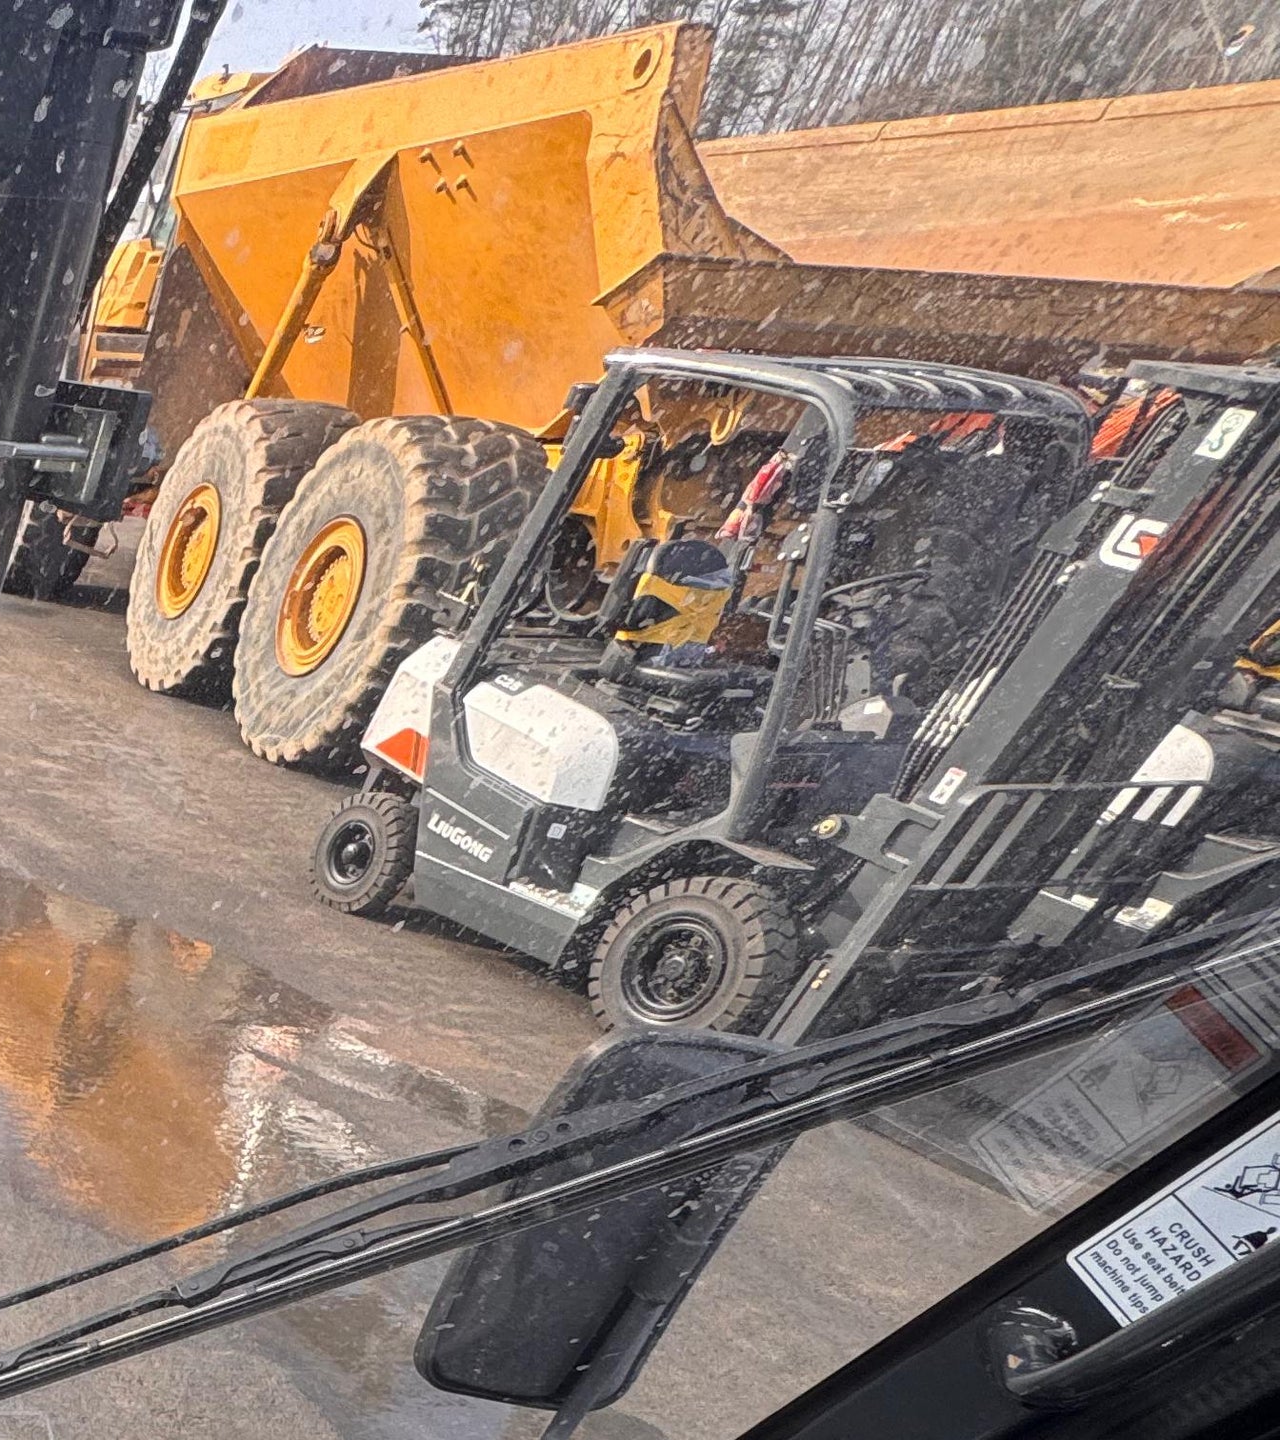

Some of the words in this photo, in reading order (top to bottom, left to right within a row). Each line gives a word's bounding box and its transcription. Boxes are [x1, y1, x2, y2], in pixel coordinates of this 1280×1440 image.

[1105, 1239, 1123, 1260] Do
[1120, 1257, 1142, 1281] not
[1122, 1227, 1145, 1254] Use
[1141, 1252, 1167, 1279] seat
[1145, 1226, 1201, 1284] HAZARD
[1169, 1221, 1215, 1268] CRUSH
[1088, 1249, 1132, 1298] machine
